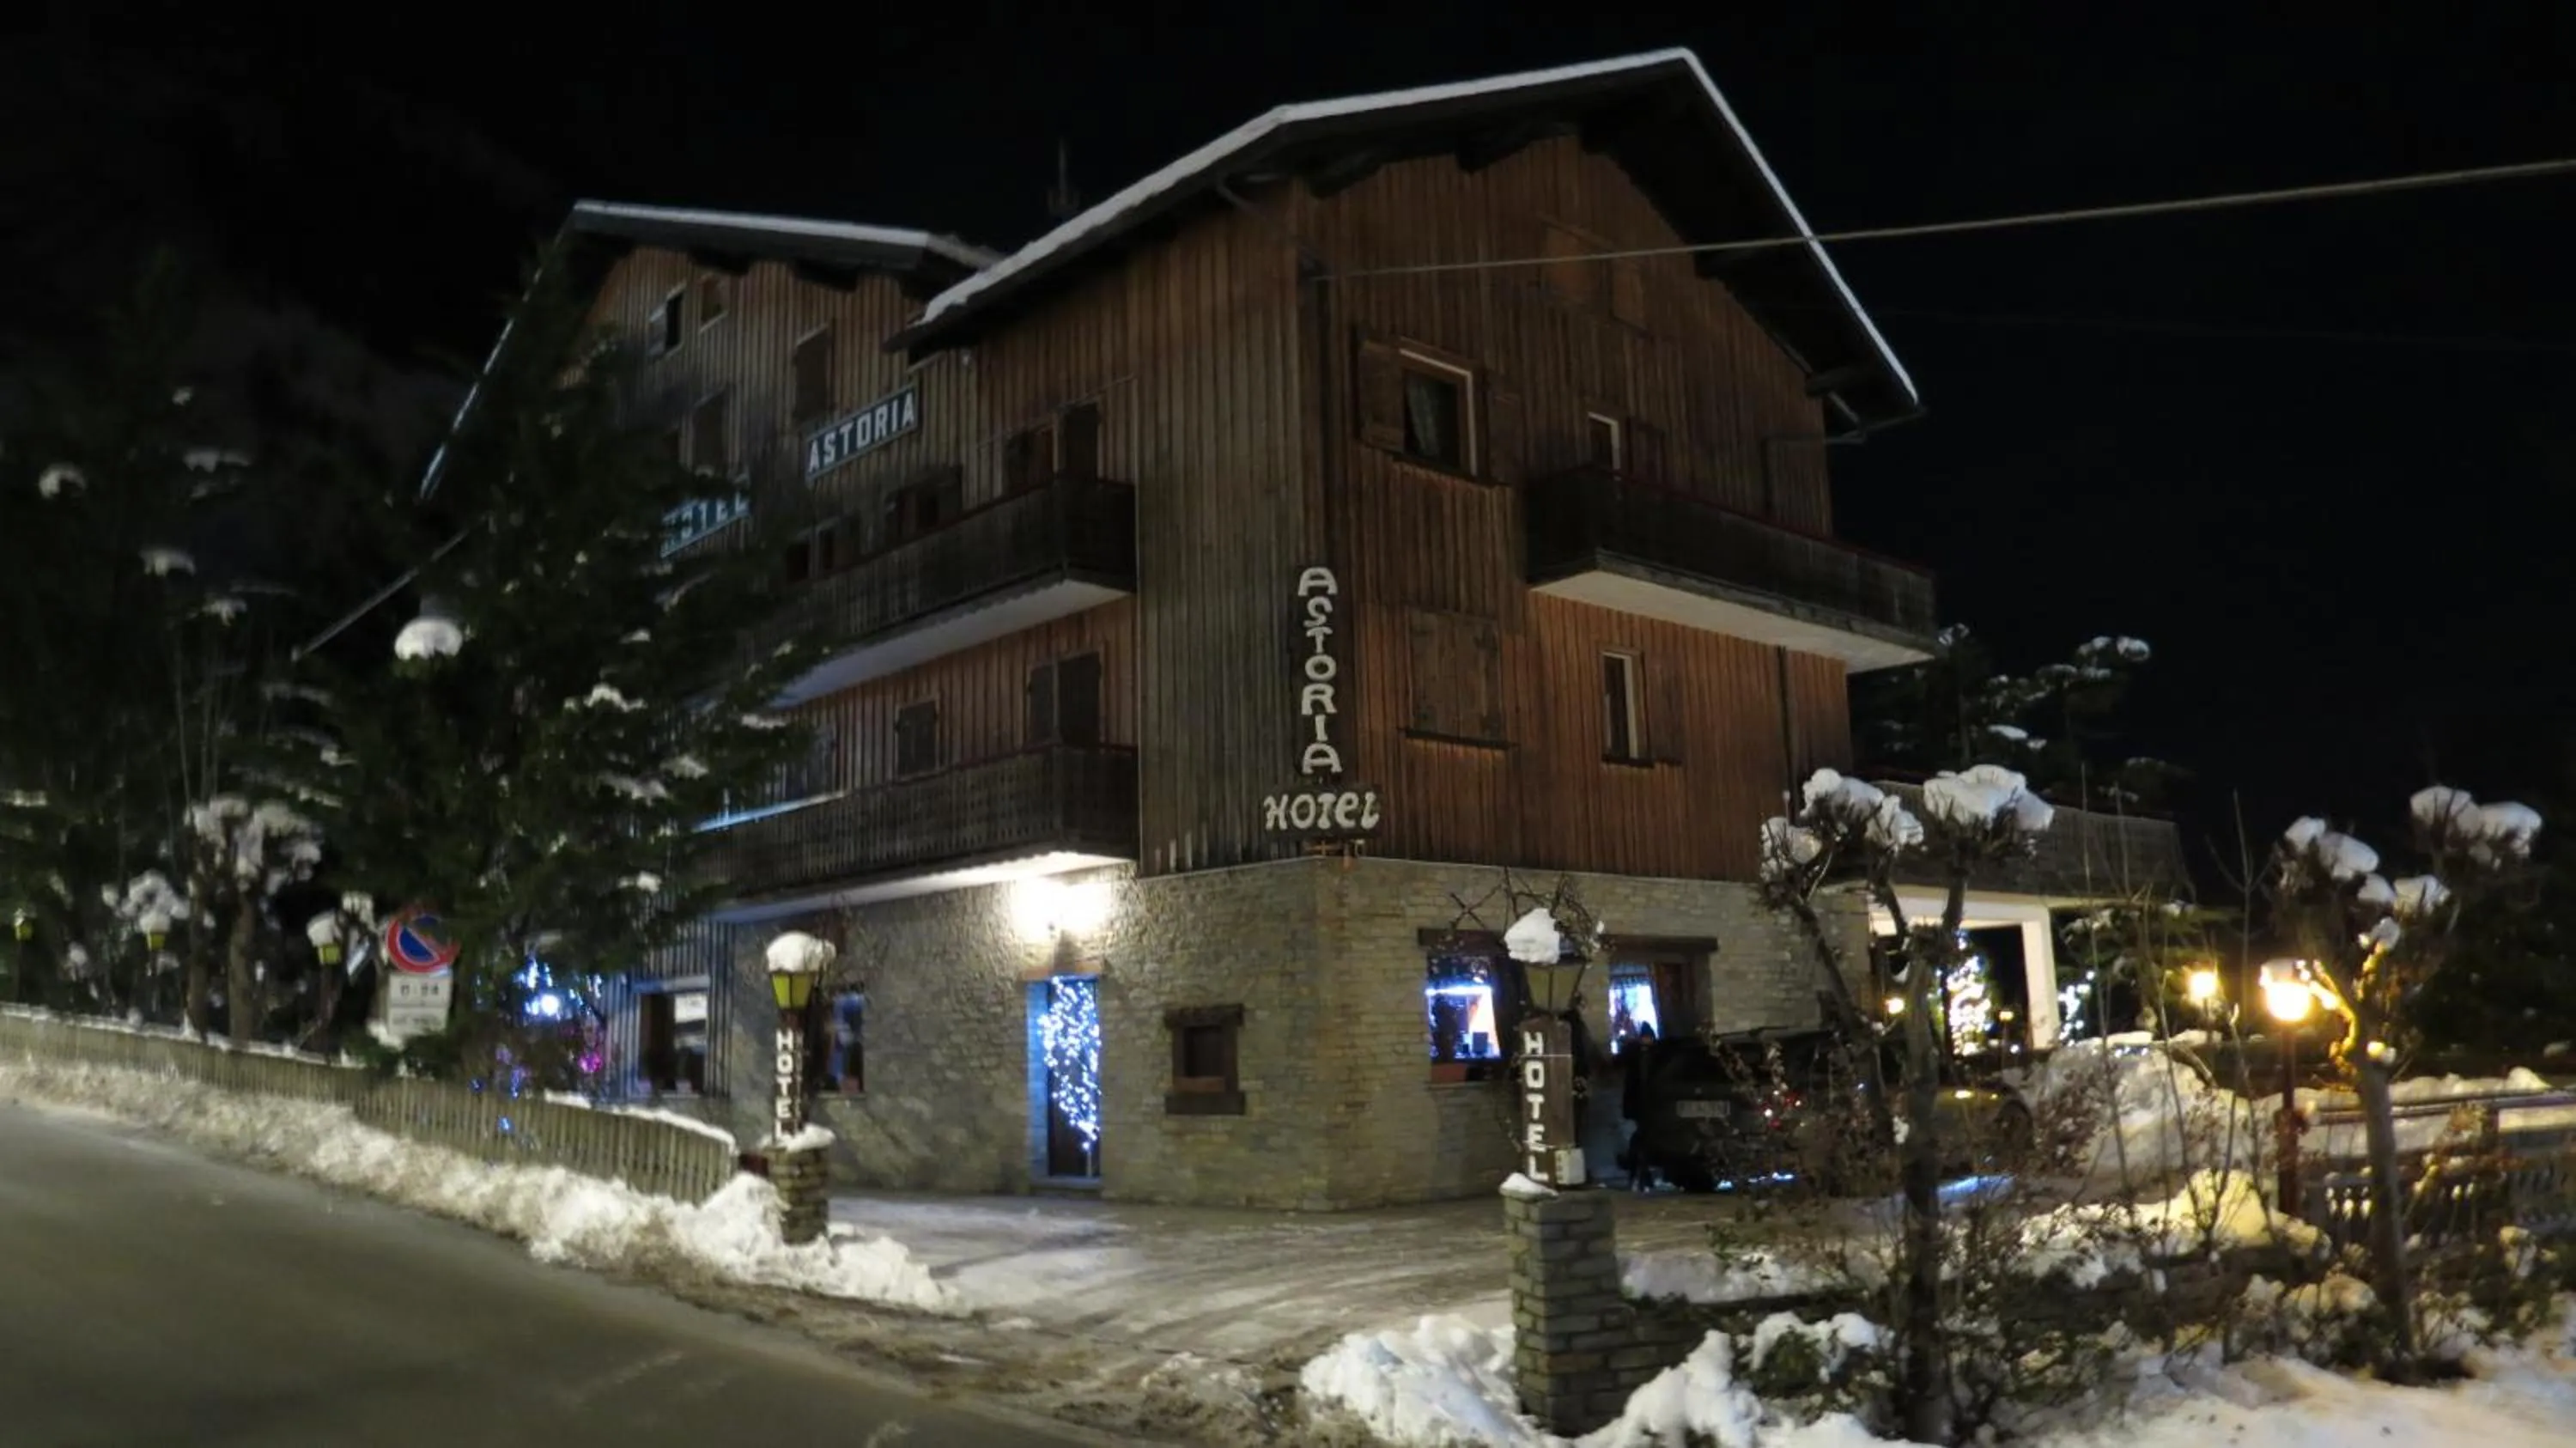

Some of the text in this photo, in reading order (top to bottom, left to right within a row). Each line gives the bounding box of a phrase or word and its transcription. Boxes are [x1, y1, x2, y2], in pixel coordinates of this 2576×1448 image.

[808, 393, 915, 472] ASTORIA
[1297, 567, 1343, 775] ASTORIA
[775, 1028, 793, 1140] HOTEL
[1524, 1031, 1549, 1181] HOTEL
